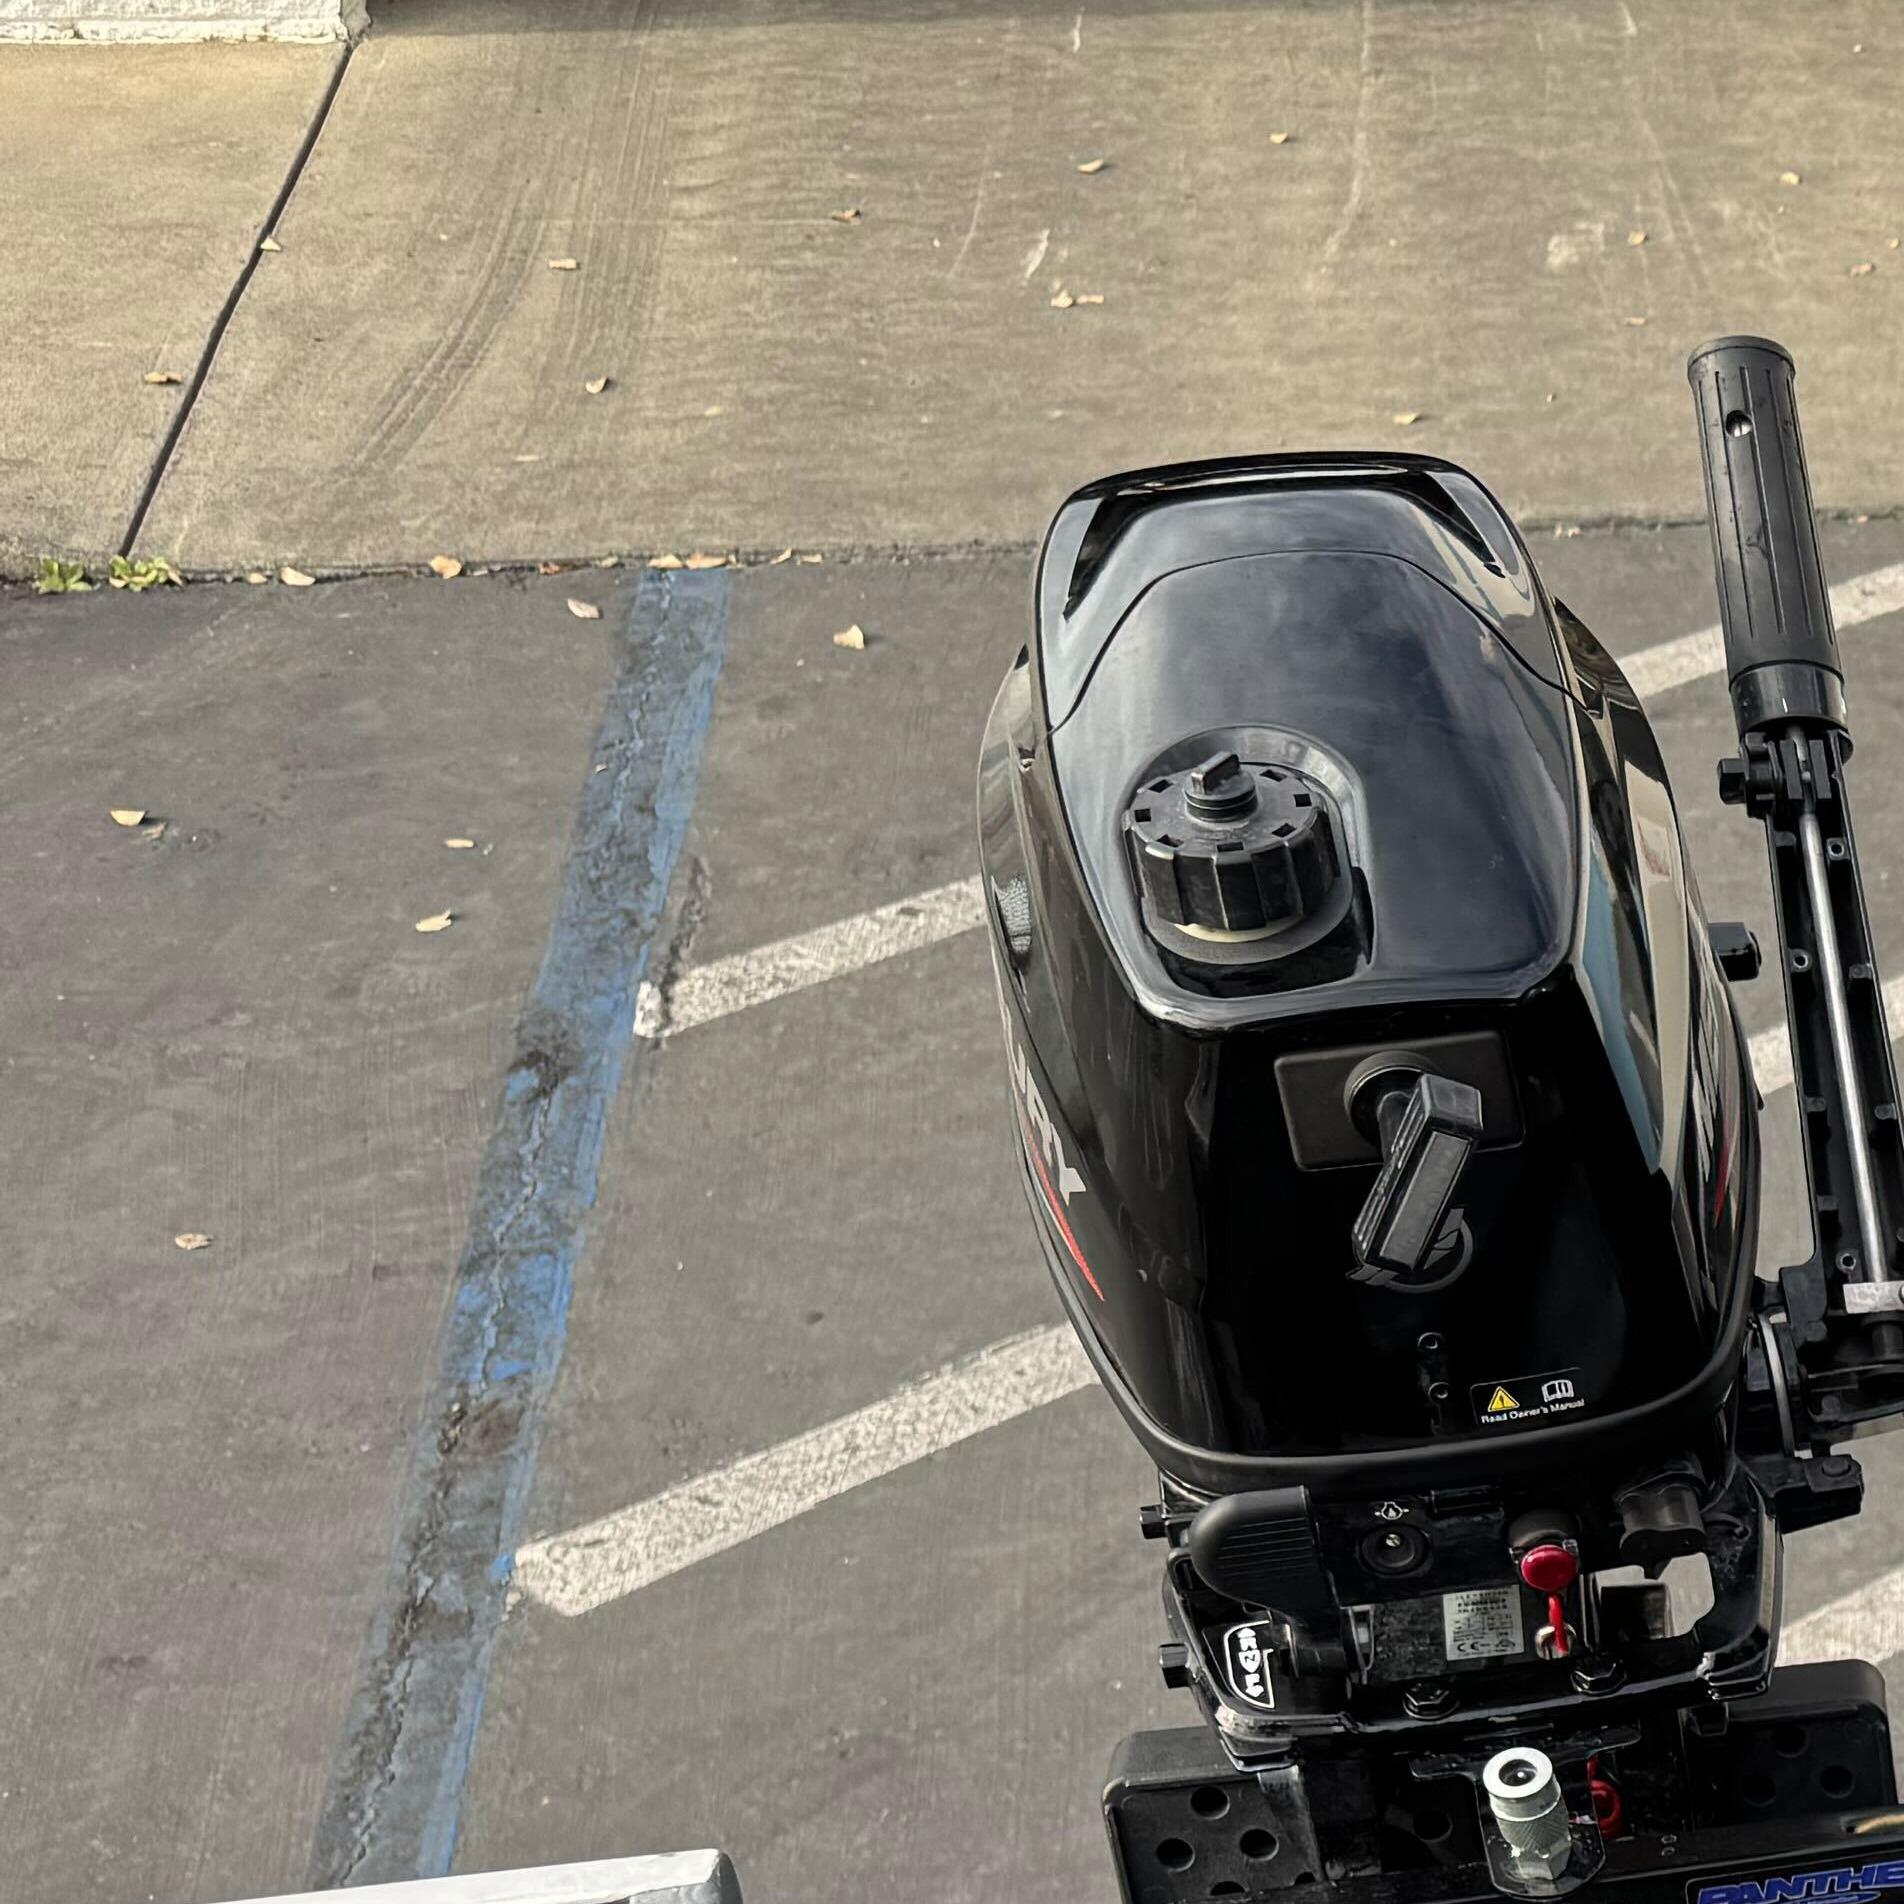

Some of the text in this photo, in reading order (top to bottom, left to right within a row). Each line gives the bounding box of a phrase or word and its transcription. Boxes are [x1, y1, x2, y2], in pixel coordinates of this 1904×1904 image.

[1481, 1398, 1585, 1424] Read Owner's Manual
